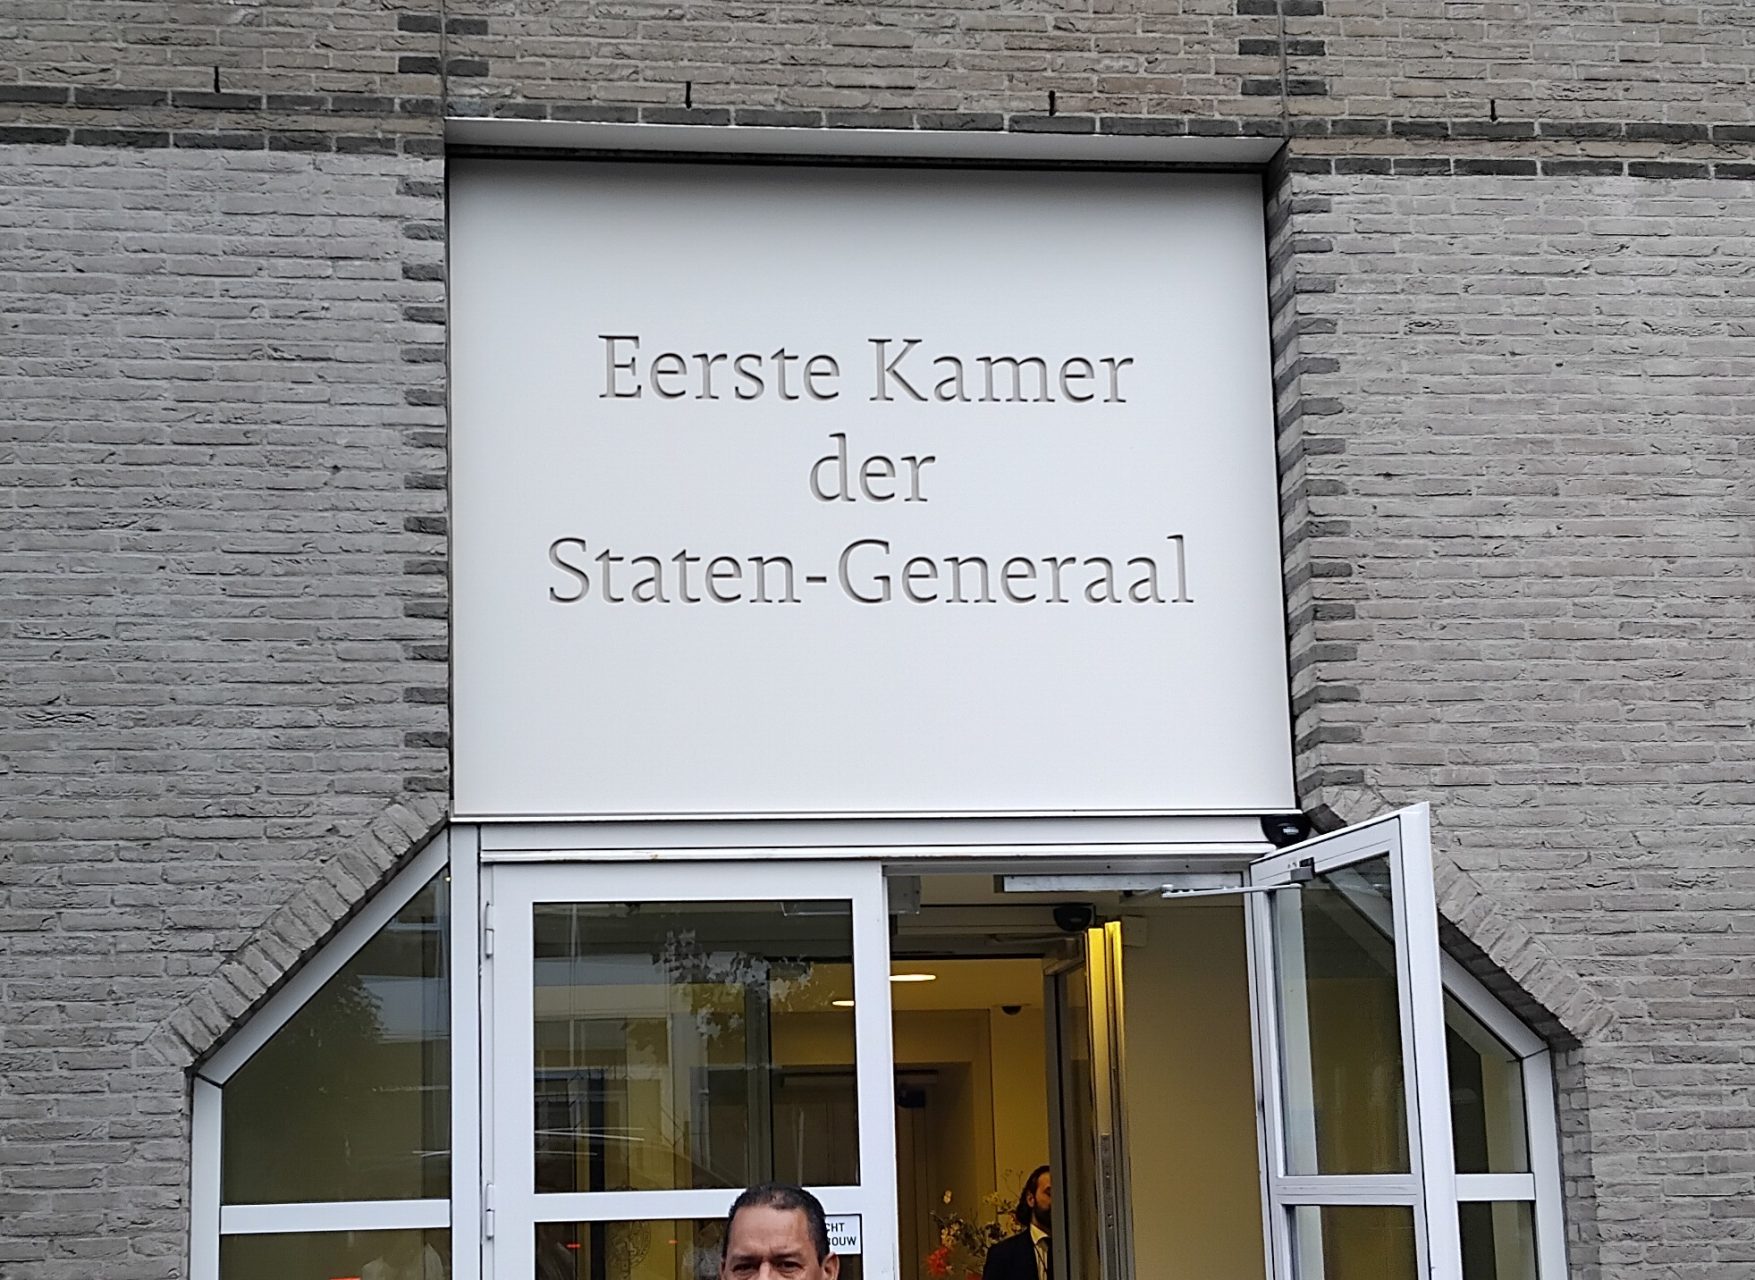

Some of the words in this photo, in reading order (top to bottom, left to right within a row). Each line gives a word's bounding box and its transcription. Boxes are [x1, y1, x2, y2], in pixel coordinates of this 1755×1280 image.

[597, 334, 841, 402] Eerste
[867, 337, 1135, 404] Kamer
[809, 431, 937, 504] der
[548, 534, 1195, 605] Staten-Generaal
